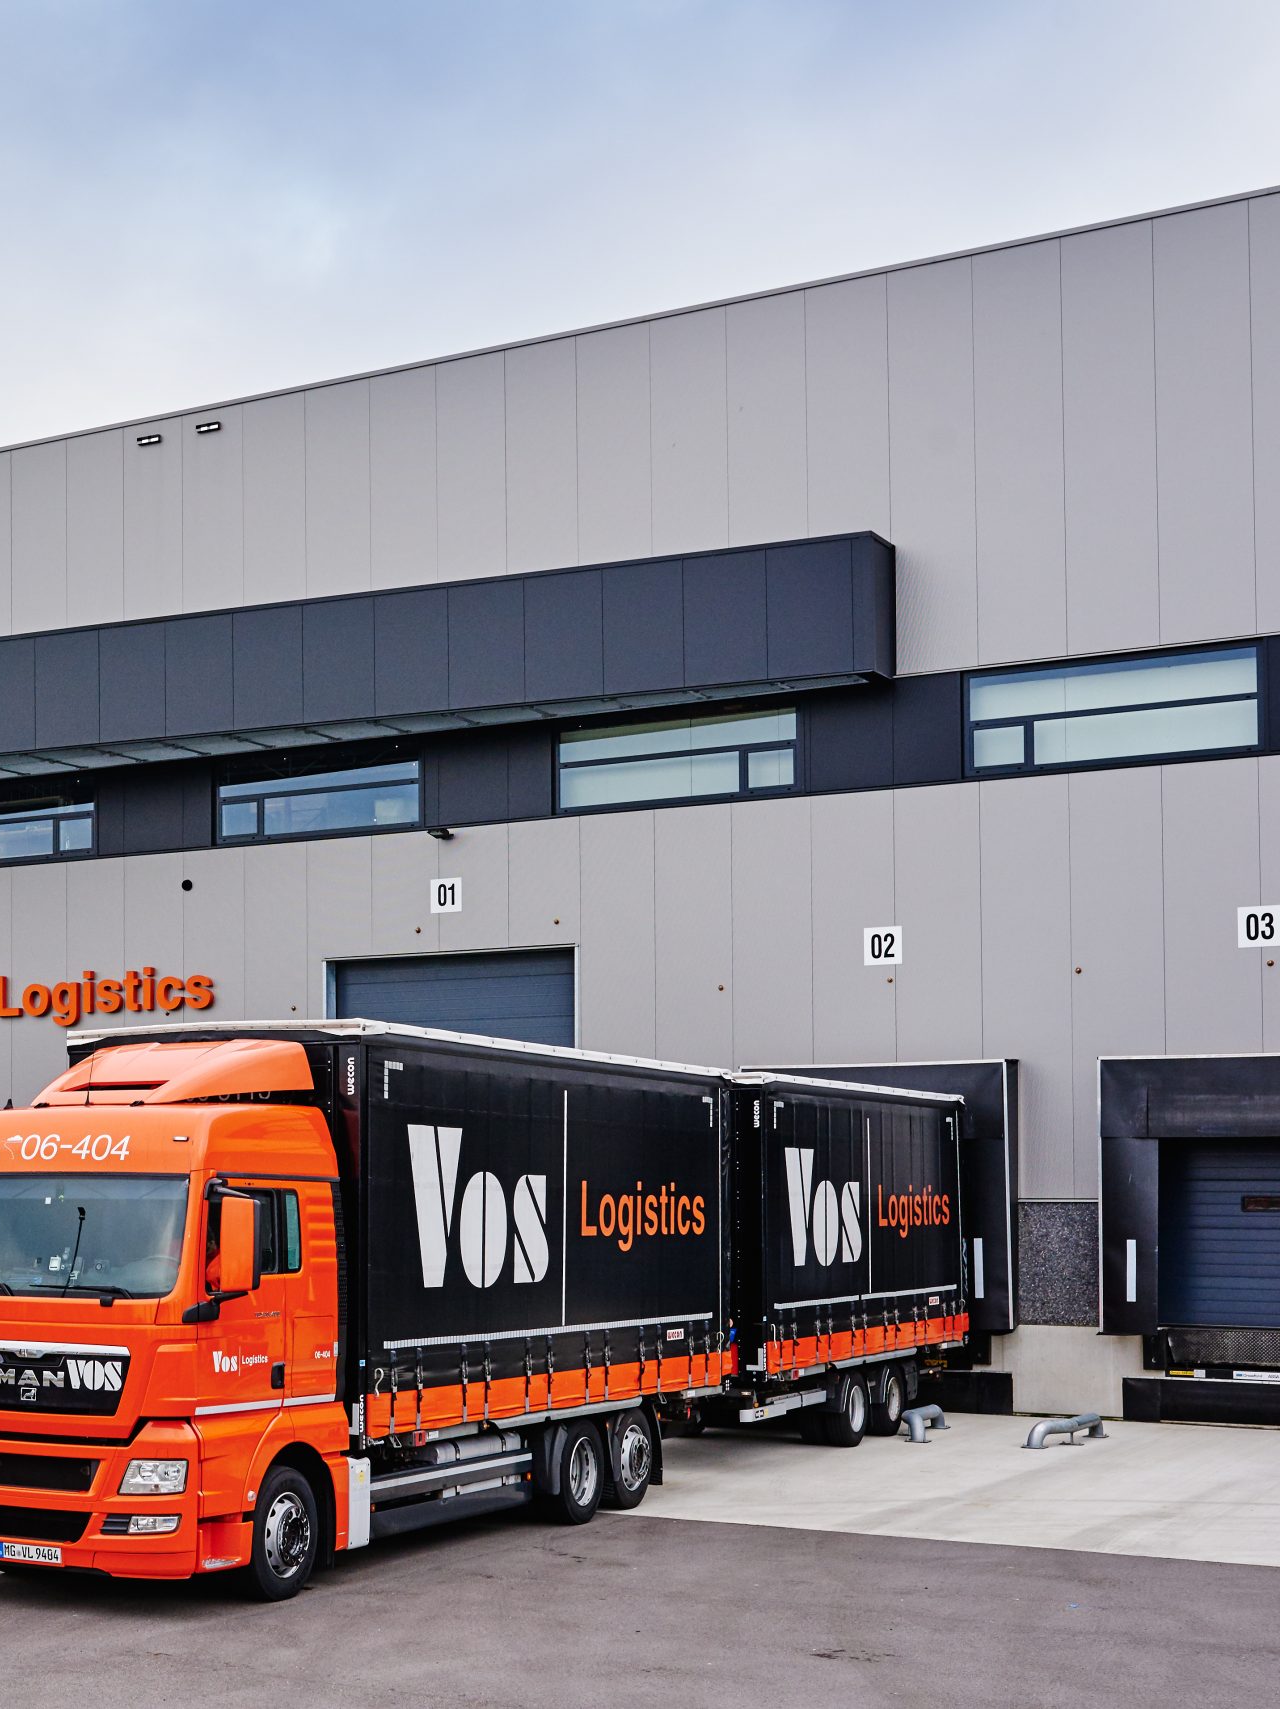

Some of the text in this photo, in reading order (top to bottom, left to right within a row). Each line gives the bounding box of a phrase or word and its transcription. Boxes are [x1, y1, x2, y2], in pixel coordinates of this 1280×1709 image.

[437, 883, 455, 907] 01
[1246, 912, 1275, 941] 03
[871, 933, 895, 959] 02
[347, 1056, 355, 1096] wecon
[20, 1134, 131, 1161] 06-404
[407, 1124, 705, 1288] Vos Logistics
[784, 1147, 950, 1267] Vos Logistics
[212, 1350, 269, 1373] Vos Logistics
[314, 1350, 331, 1360] 06-404
[4, 1544, 16, 1557] MG
[21, 1545, 34, 1559] VL
